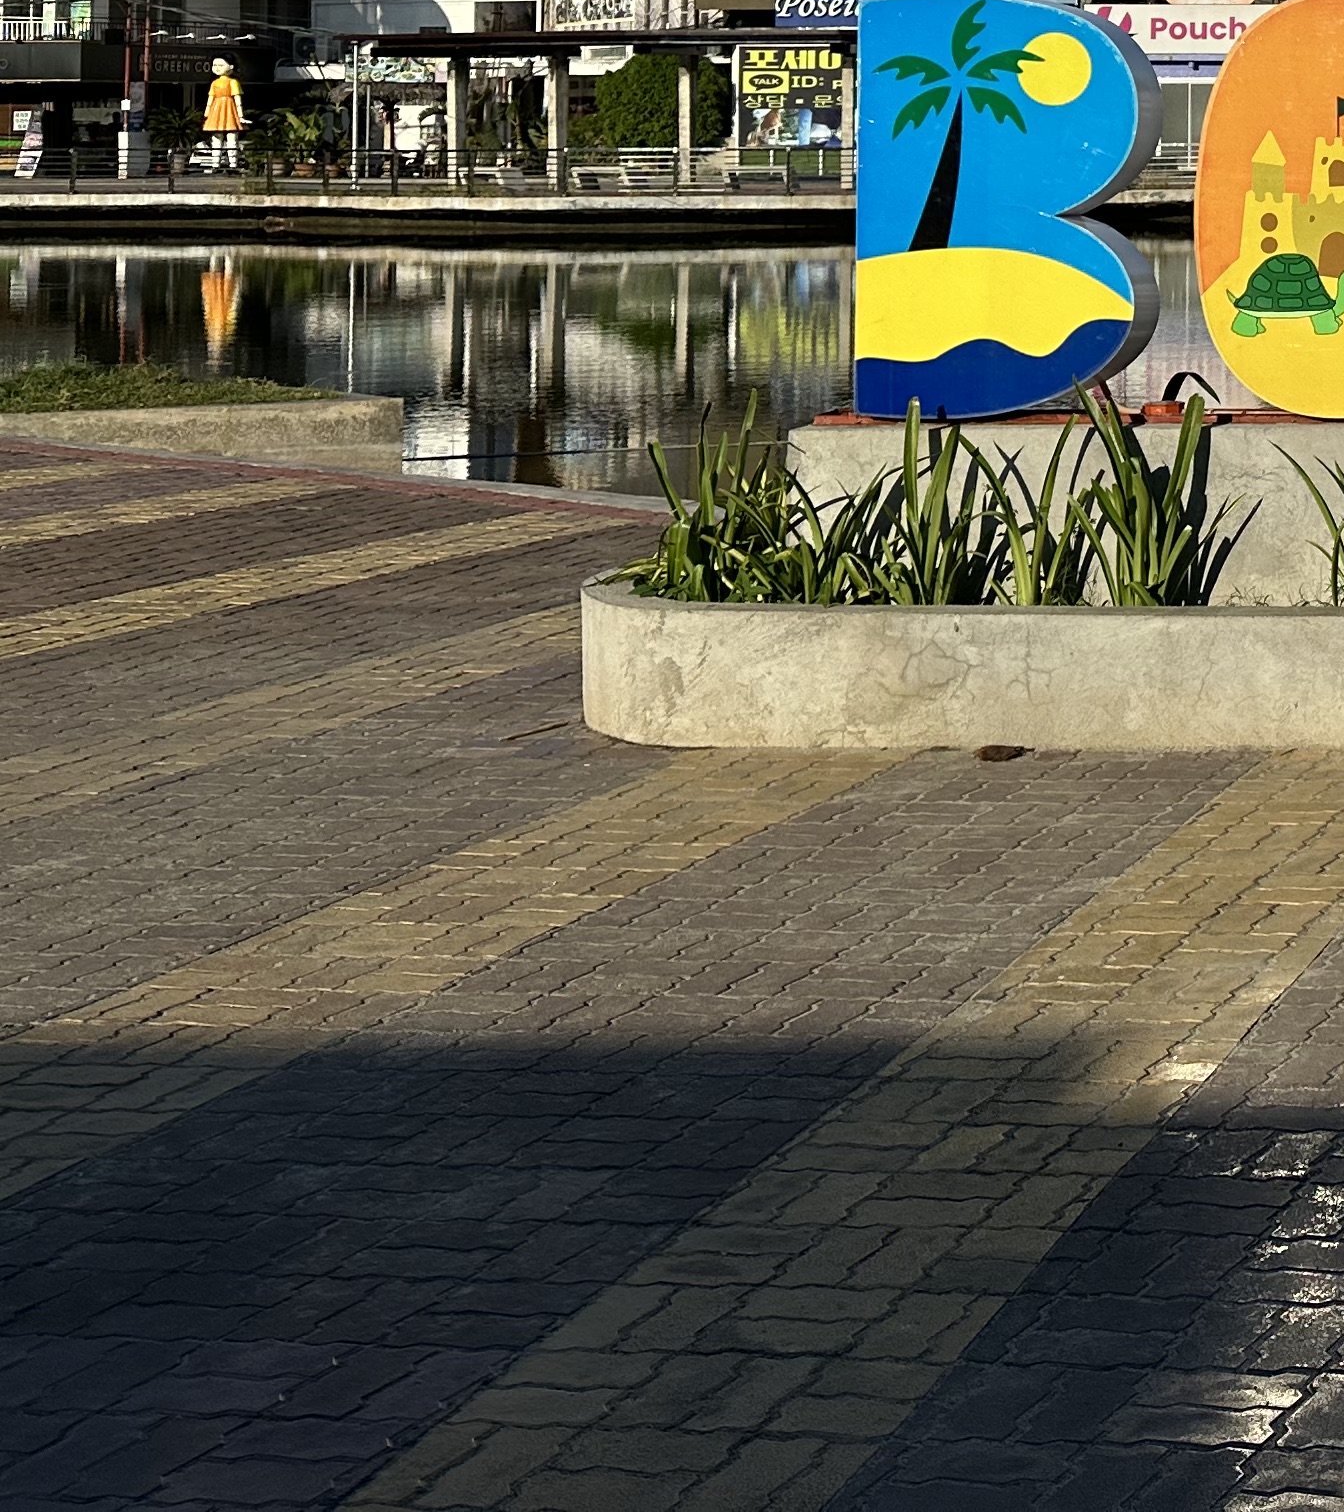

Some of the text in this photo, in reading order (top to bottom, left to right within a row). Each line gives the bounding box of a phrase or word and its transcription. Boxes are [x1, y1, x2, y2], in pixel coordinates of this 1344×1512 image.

[1150, 16, 1247, 40] Pouch
[154, 60, 190, 73] GREEN
[751, 78, 780, 86] TALK
[790, 75, 825, 88] ID:
[742, 94, 787, 109] 상담
